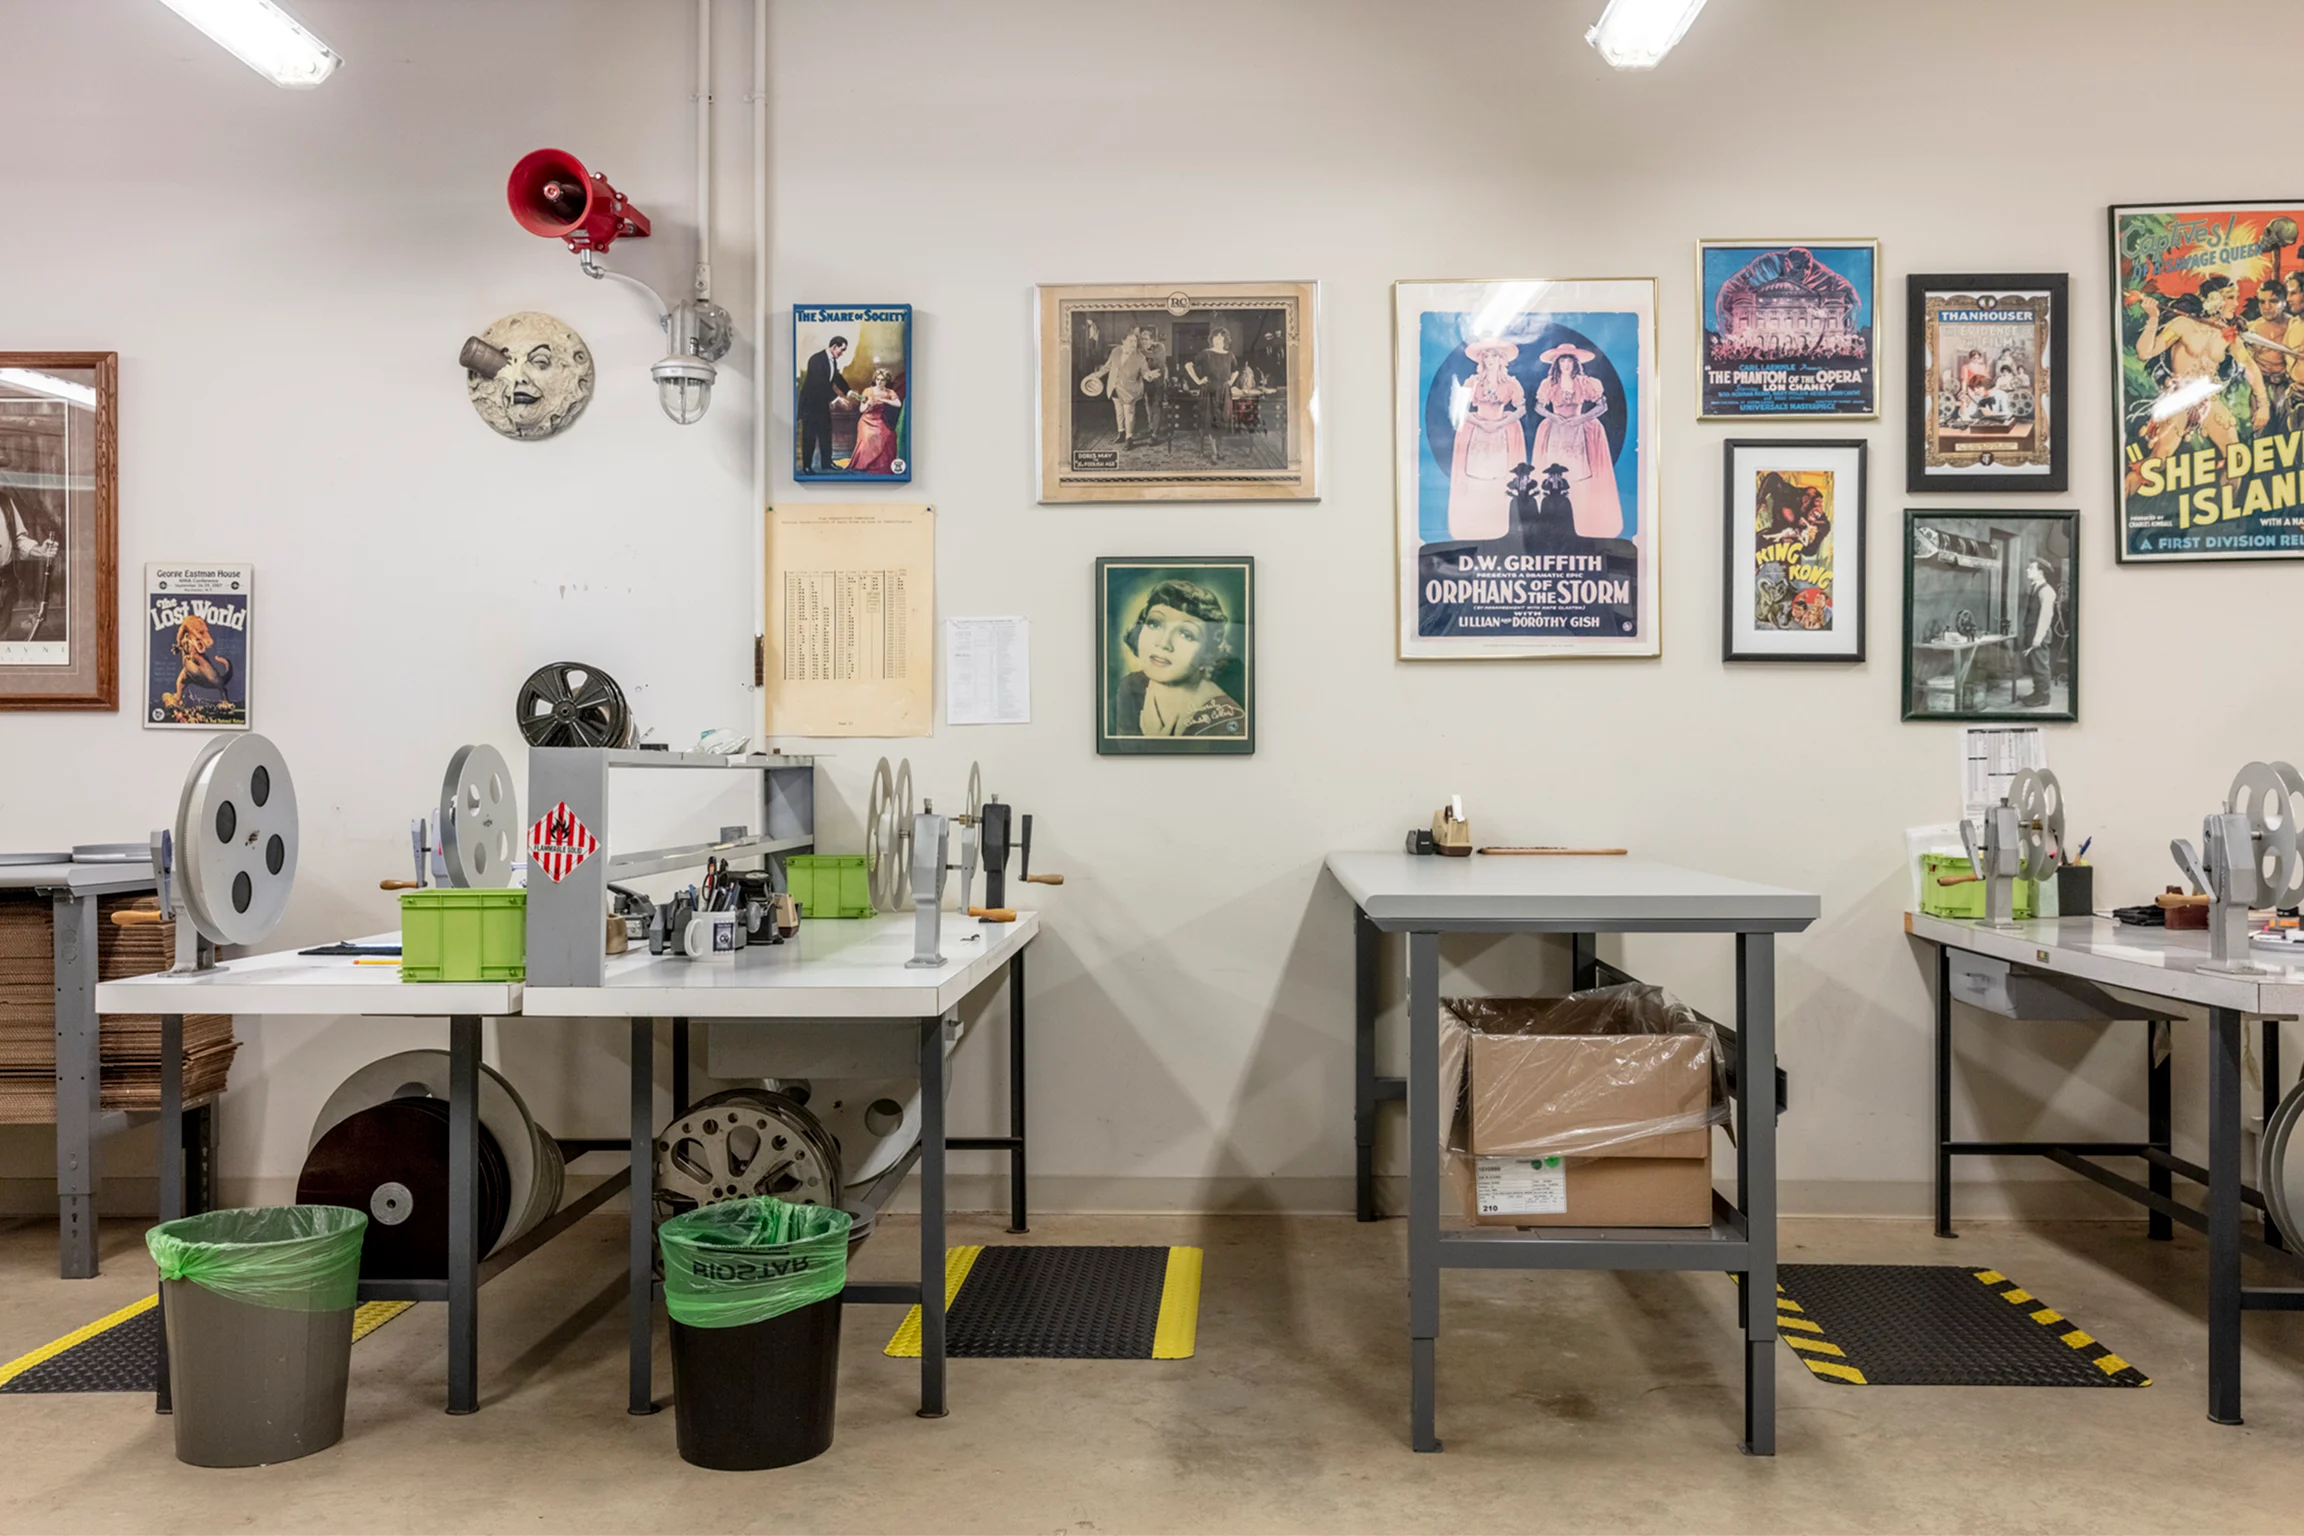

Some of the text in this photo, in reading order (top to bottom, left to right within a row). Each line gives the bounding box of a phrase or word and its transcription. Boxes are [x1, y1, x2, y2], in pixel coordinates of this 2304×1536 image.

[2120, 214, 2236, 260] Captives!
[2132, 243, 2263, 279] OF A SAVAGE QUEEN
[794, 309, 816, 322] THE
[818, 309, 854, 322] SNARE
[863, 309, 907, 322] SOCIETY
[1941, 311, 2033, 321] THANHOUSER
[1960, 326, 2019, 337] EVIDENCE
[1982, 337, 2013, 347] FILM
[1733, 371, 1787, 384] PHANTOM
[1788, 375, 1799, 383] OF
[1788, 383, 1835, 391] CHANEY
[2226, 430, 2304, 479] DEV
[2179, 471, 2304, 529] ISLAN
[2259, 518, 2282, 526] WITH
[2283, 518, 2291, 526] A
[2140, 538, 2152, 550] A
[2159, 537, 2200, 549] FIRST
[2206, 535, 2276, 548] DIVISION
[1755, 542, 1804, 565] KING
[1458, 555, 1602, 571] D.W. GRIFFITH
[184, 569, 216, 578] Eastman
[217, 570, 241, 578] House
[1789, 564, 1833, 590] KONG
[1425, 579, 1630, 604] ORPHANS OF THE STORM
[150, 599, 247, 631] Lost World
[1458, 616, 1500, 627] LILLIAN
[1512, 616, 1568, 628] DOROTHY
[1569, 616, 1600, 628] GISH
[534, 845, 583, 854] FLAMMABLE SOLID
